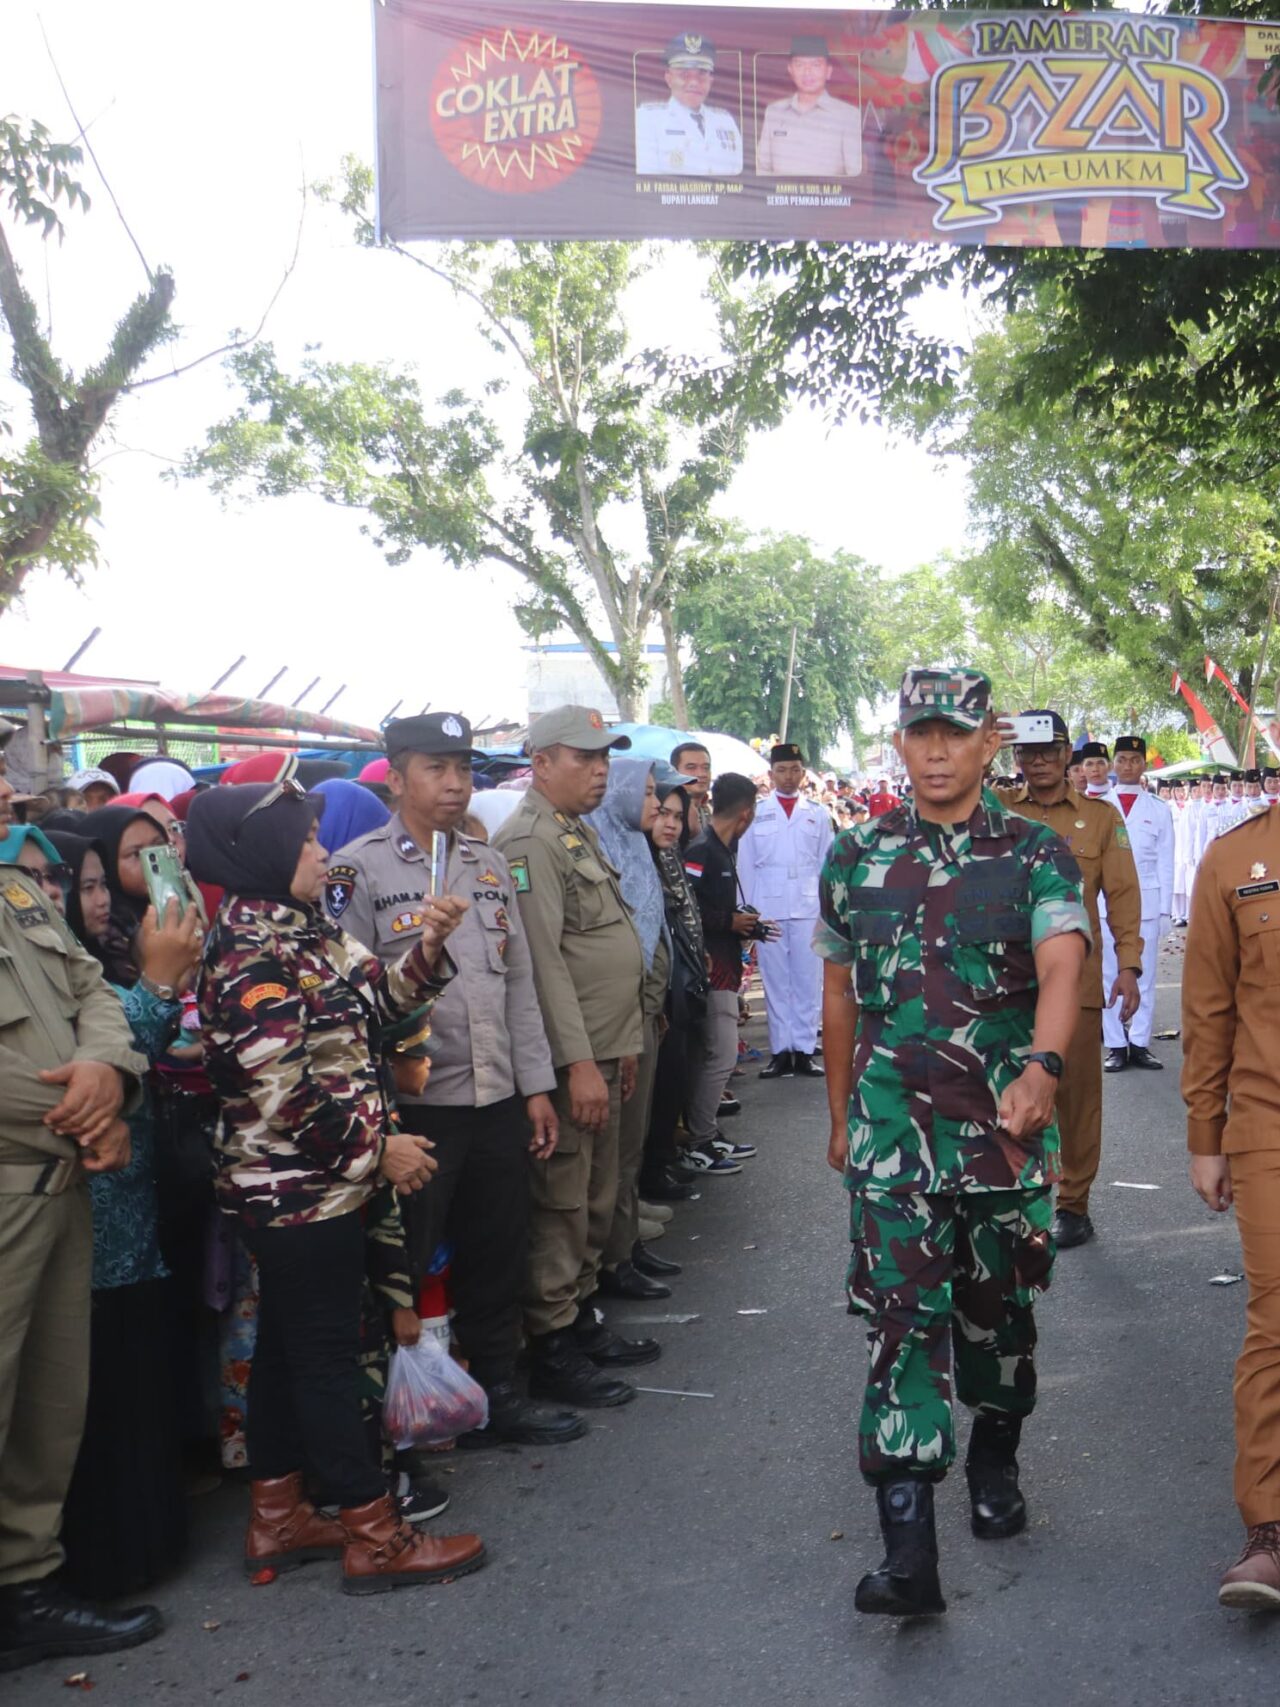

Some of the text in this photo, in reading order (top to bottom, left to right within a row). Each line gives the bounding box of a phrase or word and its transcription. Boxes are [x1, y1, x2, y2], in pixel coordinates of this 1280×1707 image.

[976, 20, 1175, 62] PAMERAN
[435, 61, 579, 118] COKLAT
[483, 96, 577, 144] EXTRA
[915, 57, 1246, 184] BAZAR
[983, 158, 1165, 192] IKM-UMKM
